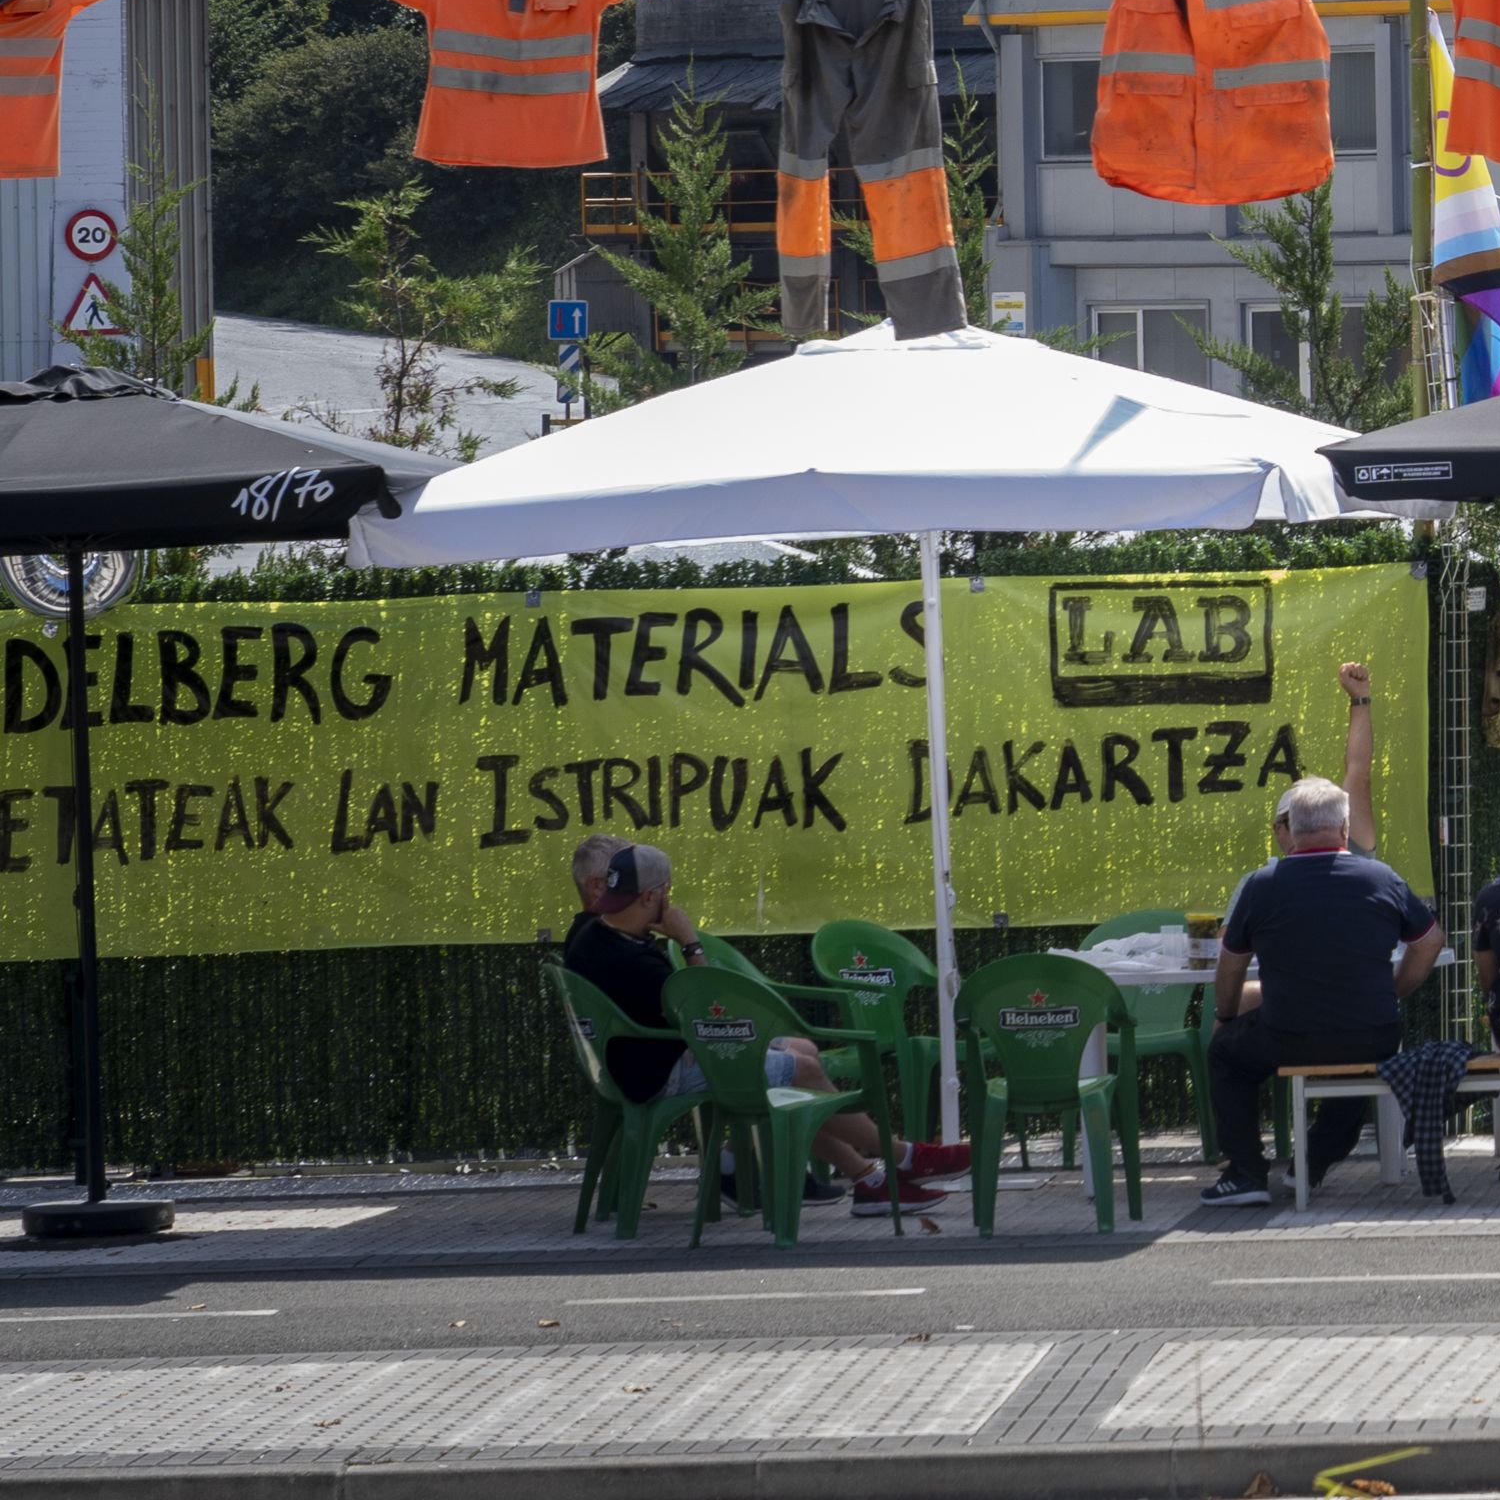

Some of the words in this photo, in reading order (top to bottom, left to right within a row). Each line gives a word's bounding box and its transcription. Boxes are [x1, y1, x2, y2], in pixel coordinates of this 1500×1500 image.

[77, 226, 106, 244] 20
[231, 467, 335, 522] 18/70
[459, 601, 927, 708] MATERIALS
[1062, 595, 1254, 665] LAB
[476, 747, 846, 850] ISTRIPUAK
[904, 721, 1307, 825] DAKARTZA
[697, 1023, 751, 1037] Heineken
[1005, 1011, 1074, 1025] Heineken
